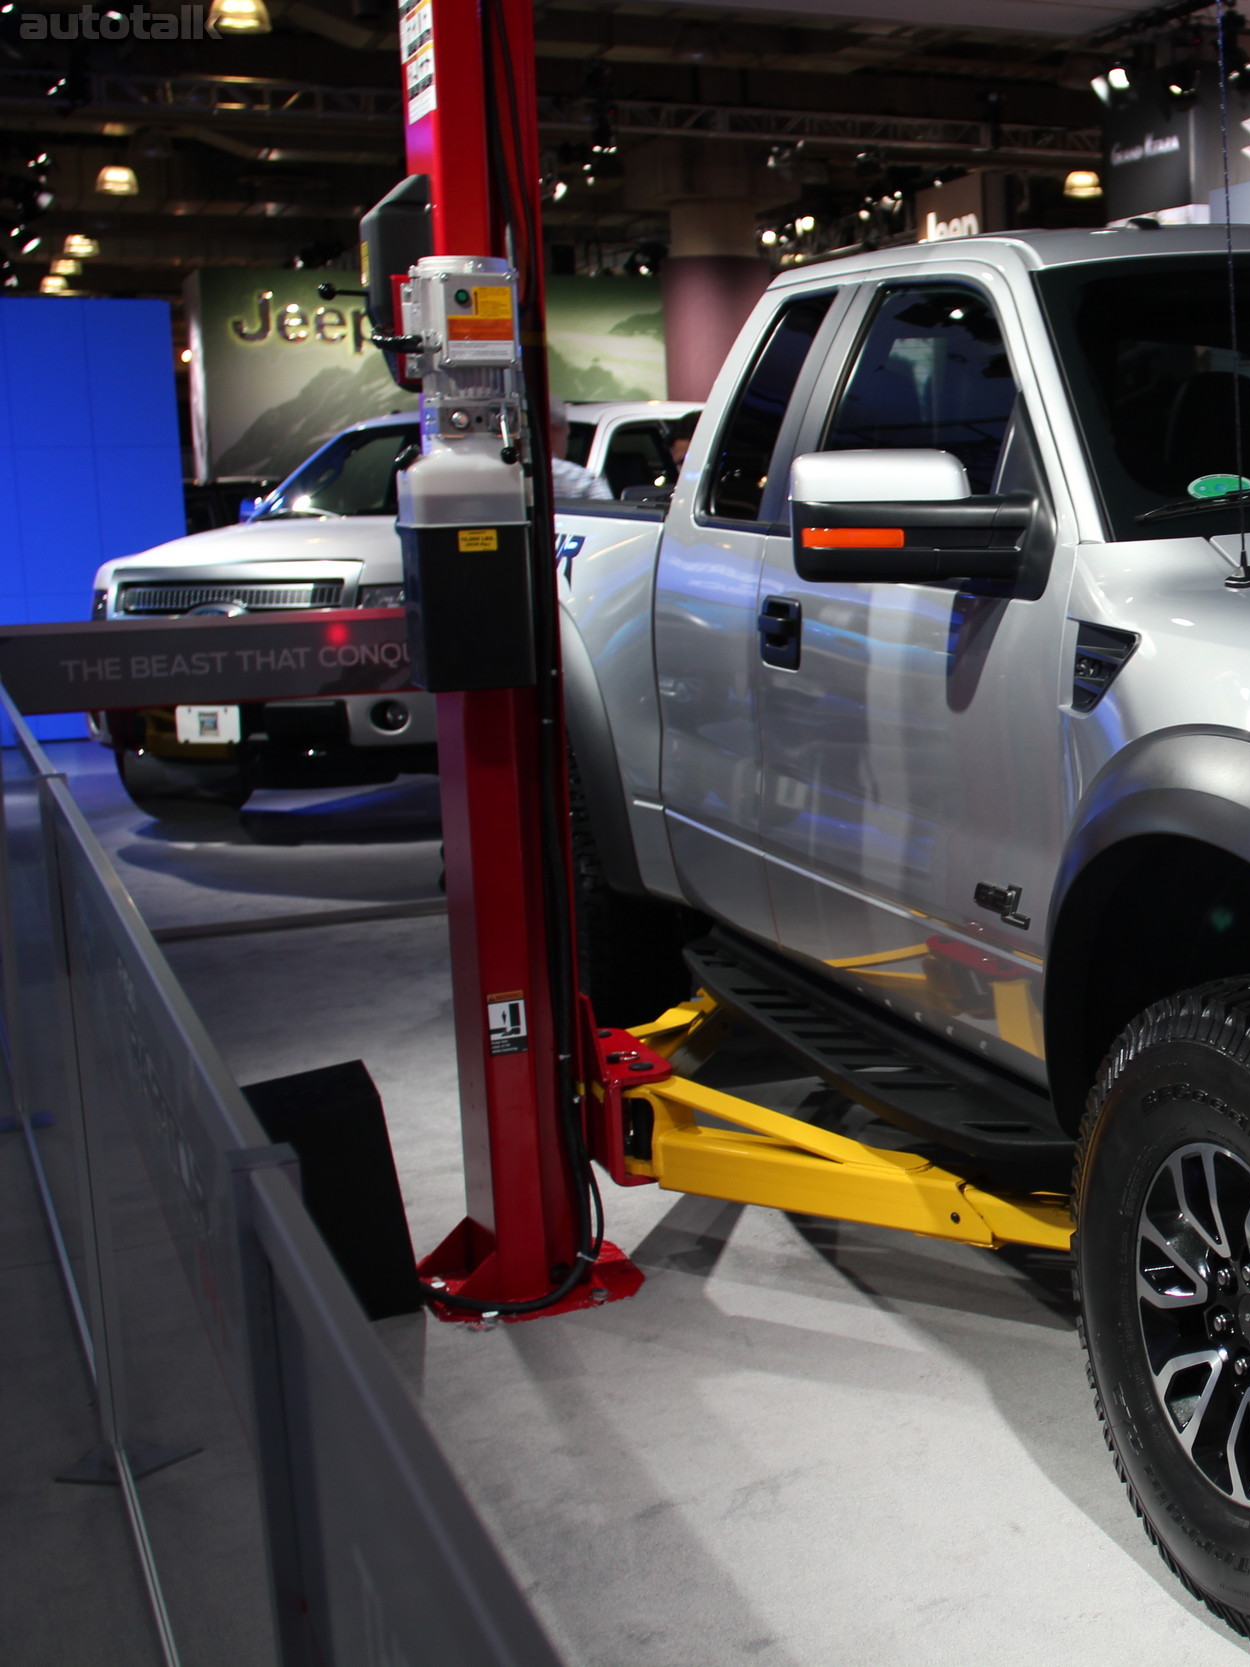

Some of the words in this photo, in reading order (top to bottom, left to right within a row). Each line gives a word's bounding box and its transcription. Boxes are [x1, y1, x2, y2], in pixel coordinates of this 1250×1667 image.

[60, 657, 123, 683] THE
[130, 651, 229, 679] BEAST
[234, 646, 312, 673] THAT
